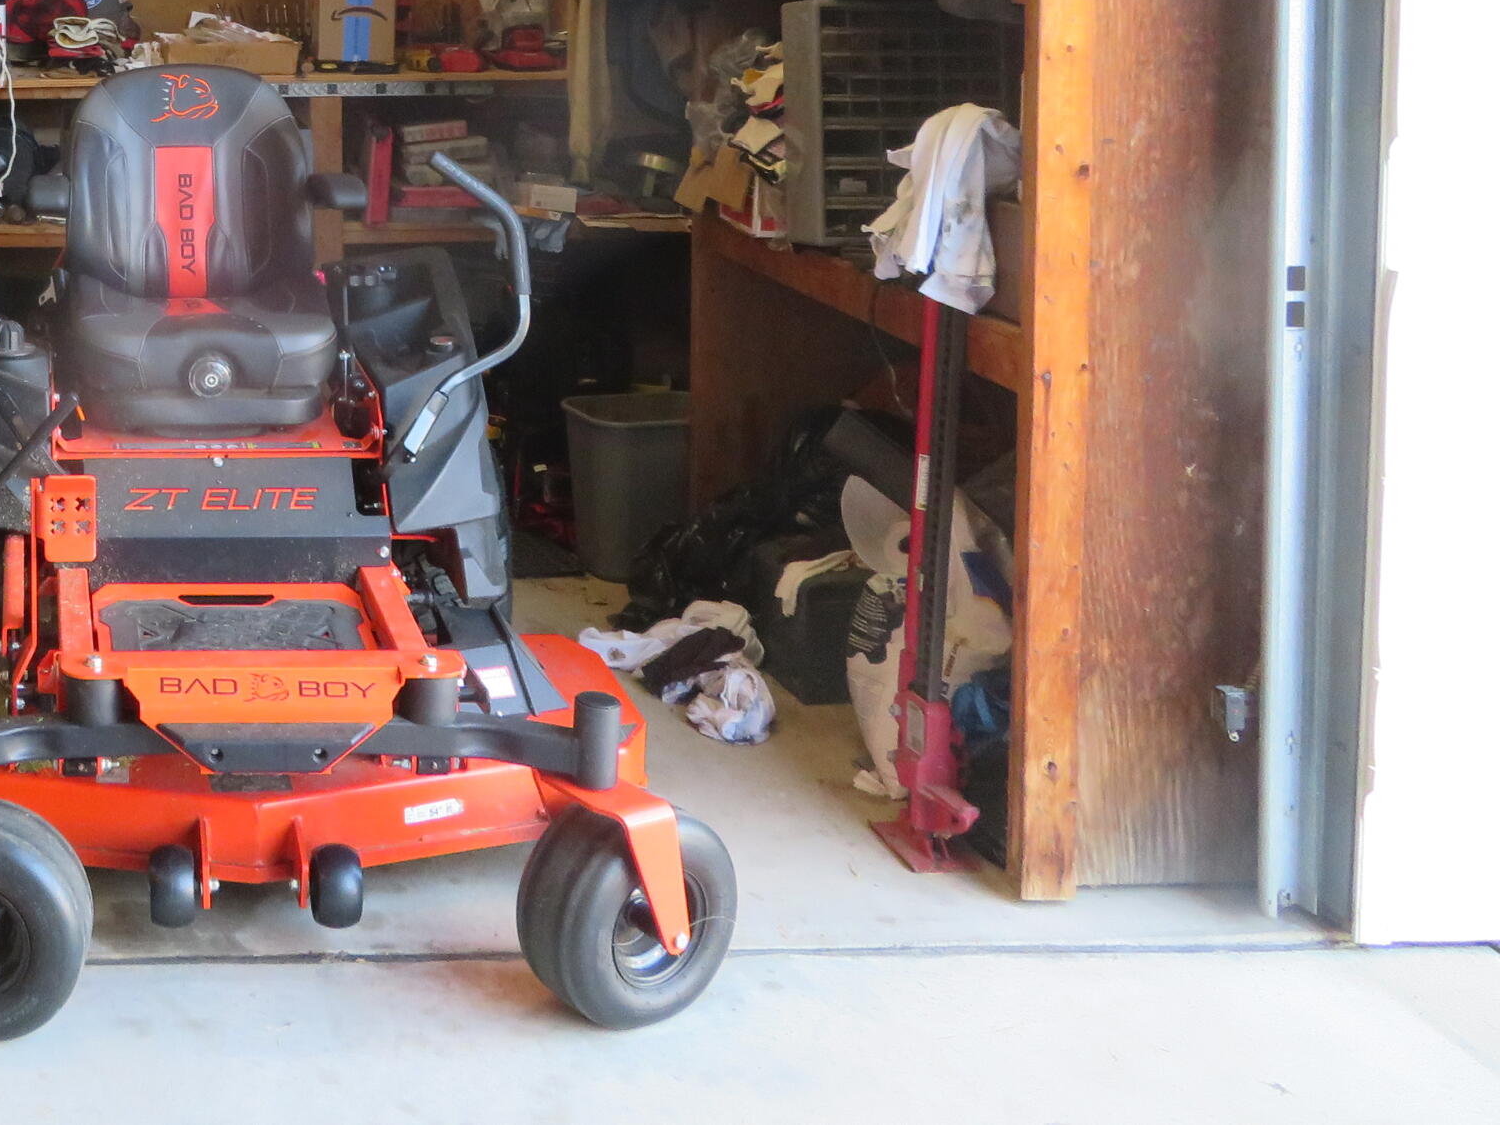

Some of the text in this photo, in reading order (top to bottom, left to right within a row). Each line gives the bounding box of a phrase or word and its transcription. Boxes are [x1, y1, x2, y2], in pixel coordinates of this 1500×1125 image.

[178, 173, 197, 276] BAD BOY
[123, 487, 319, 511] ZT ELITE
[159, 676, 377, 699] BAD BOY
